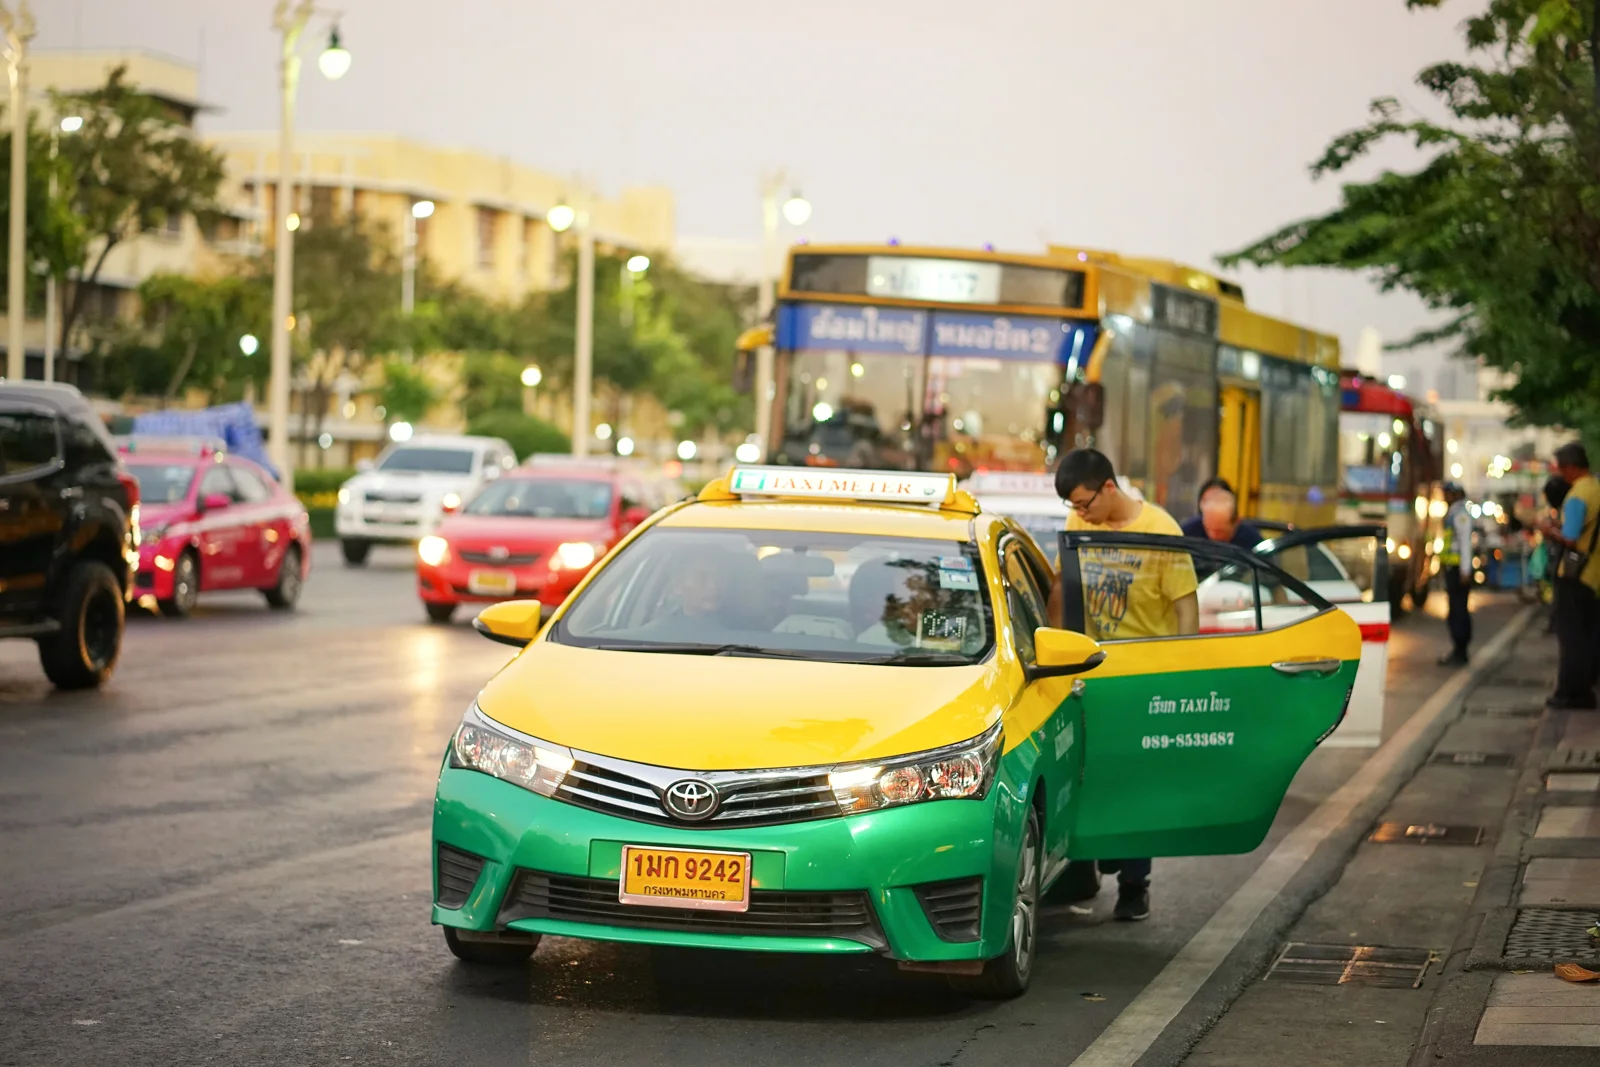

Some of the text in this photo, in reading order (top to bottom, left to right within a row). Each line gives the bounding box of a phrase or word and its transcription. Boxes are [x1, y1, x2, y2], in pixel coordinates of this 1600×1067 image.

[1179, 698, 1208, 714] TAXI
[1141, 731, 1235, 749] 089-8533687
[634, 853, 741, 883] 1มก 9242
[643, 884, 726, 900] กรงเทพมหานคร
